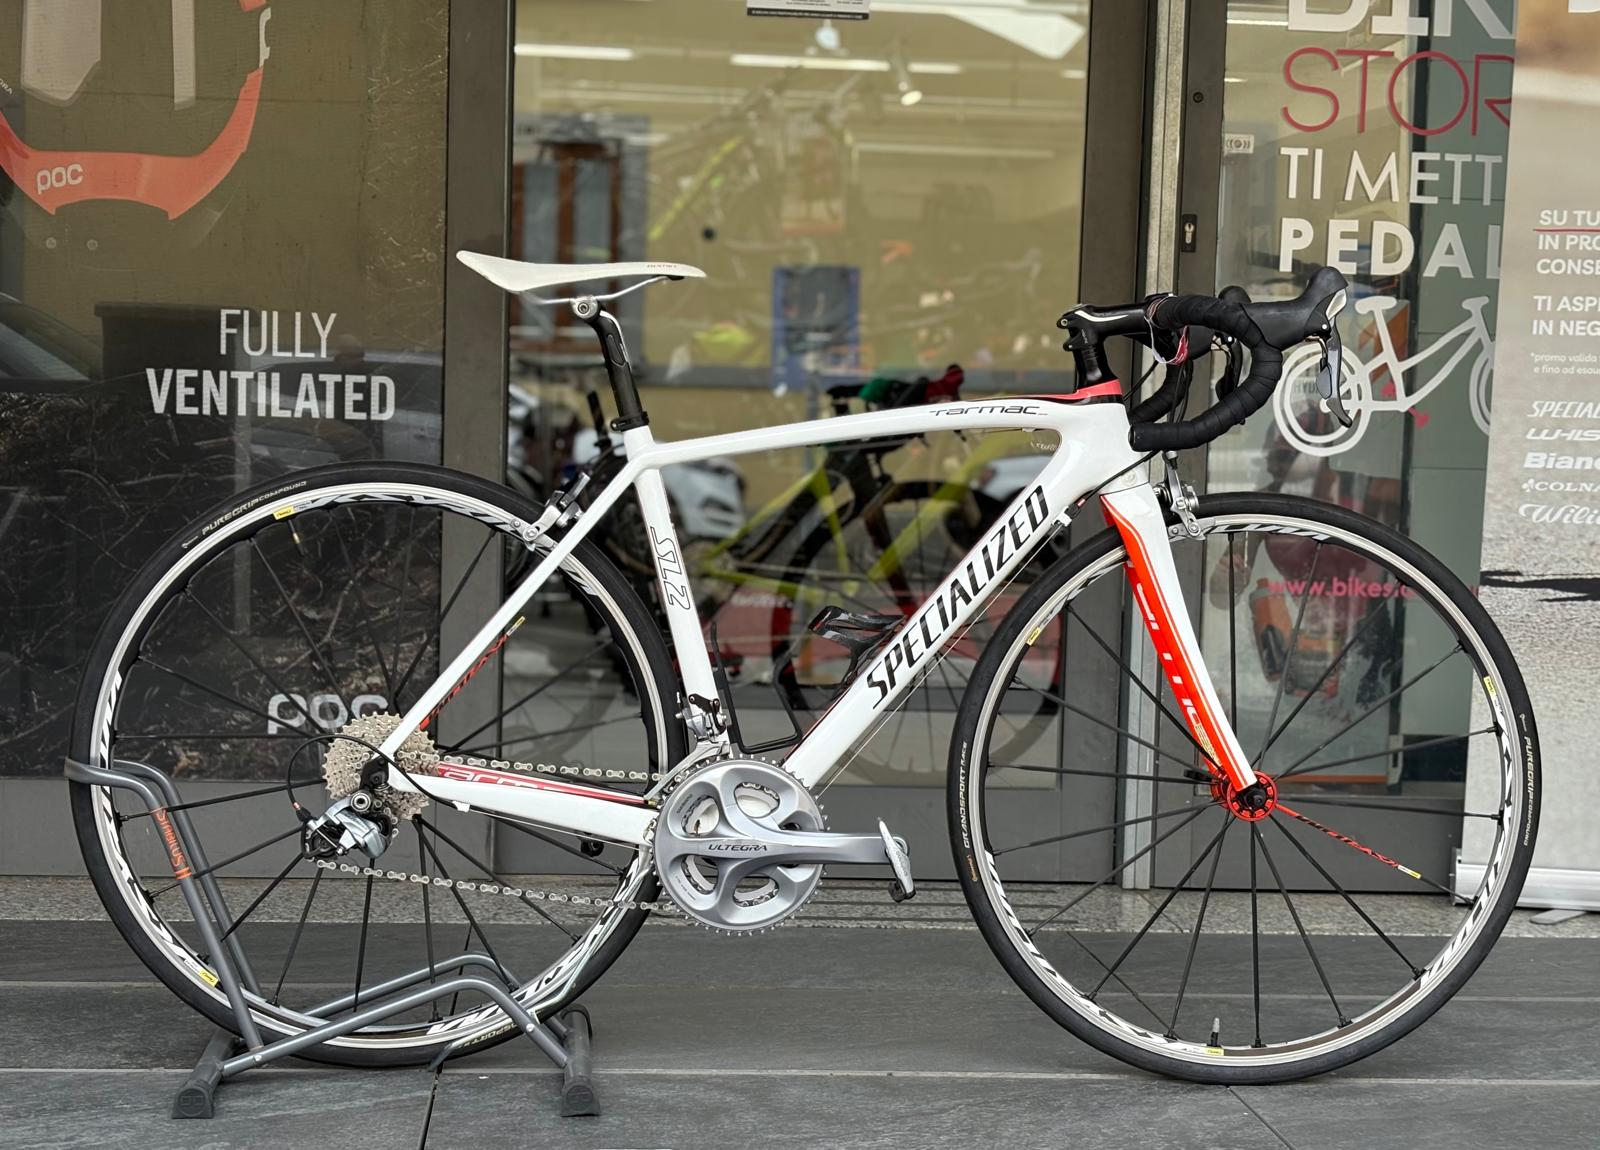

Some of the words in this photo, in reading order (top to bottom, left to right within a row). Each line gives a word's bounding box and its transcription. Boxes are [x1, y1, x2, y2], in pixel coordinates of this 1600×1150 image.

[1280, 147, 1323, 200] TI
[1344, 150, 1503, 206] METT
[1539, 209, 1568, 226] SU
[1573, 210, 1600, 226] TU
[1538, 234, 1560, 250] IN
[1532, 295, 1553, 312] TI
[1556, 295, 1600, 313] ASP
[218, 308, 338, 360] FULLY
[1532, 319, 1554, 336] IN
[1559, 319, 1600, 337] NEG
[145, 366, 397, 422] VENTILATED
[866, 484, 1050, 710] SPECIALIZED
[707, 843, 768, 852] ULTEGRA
